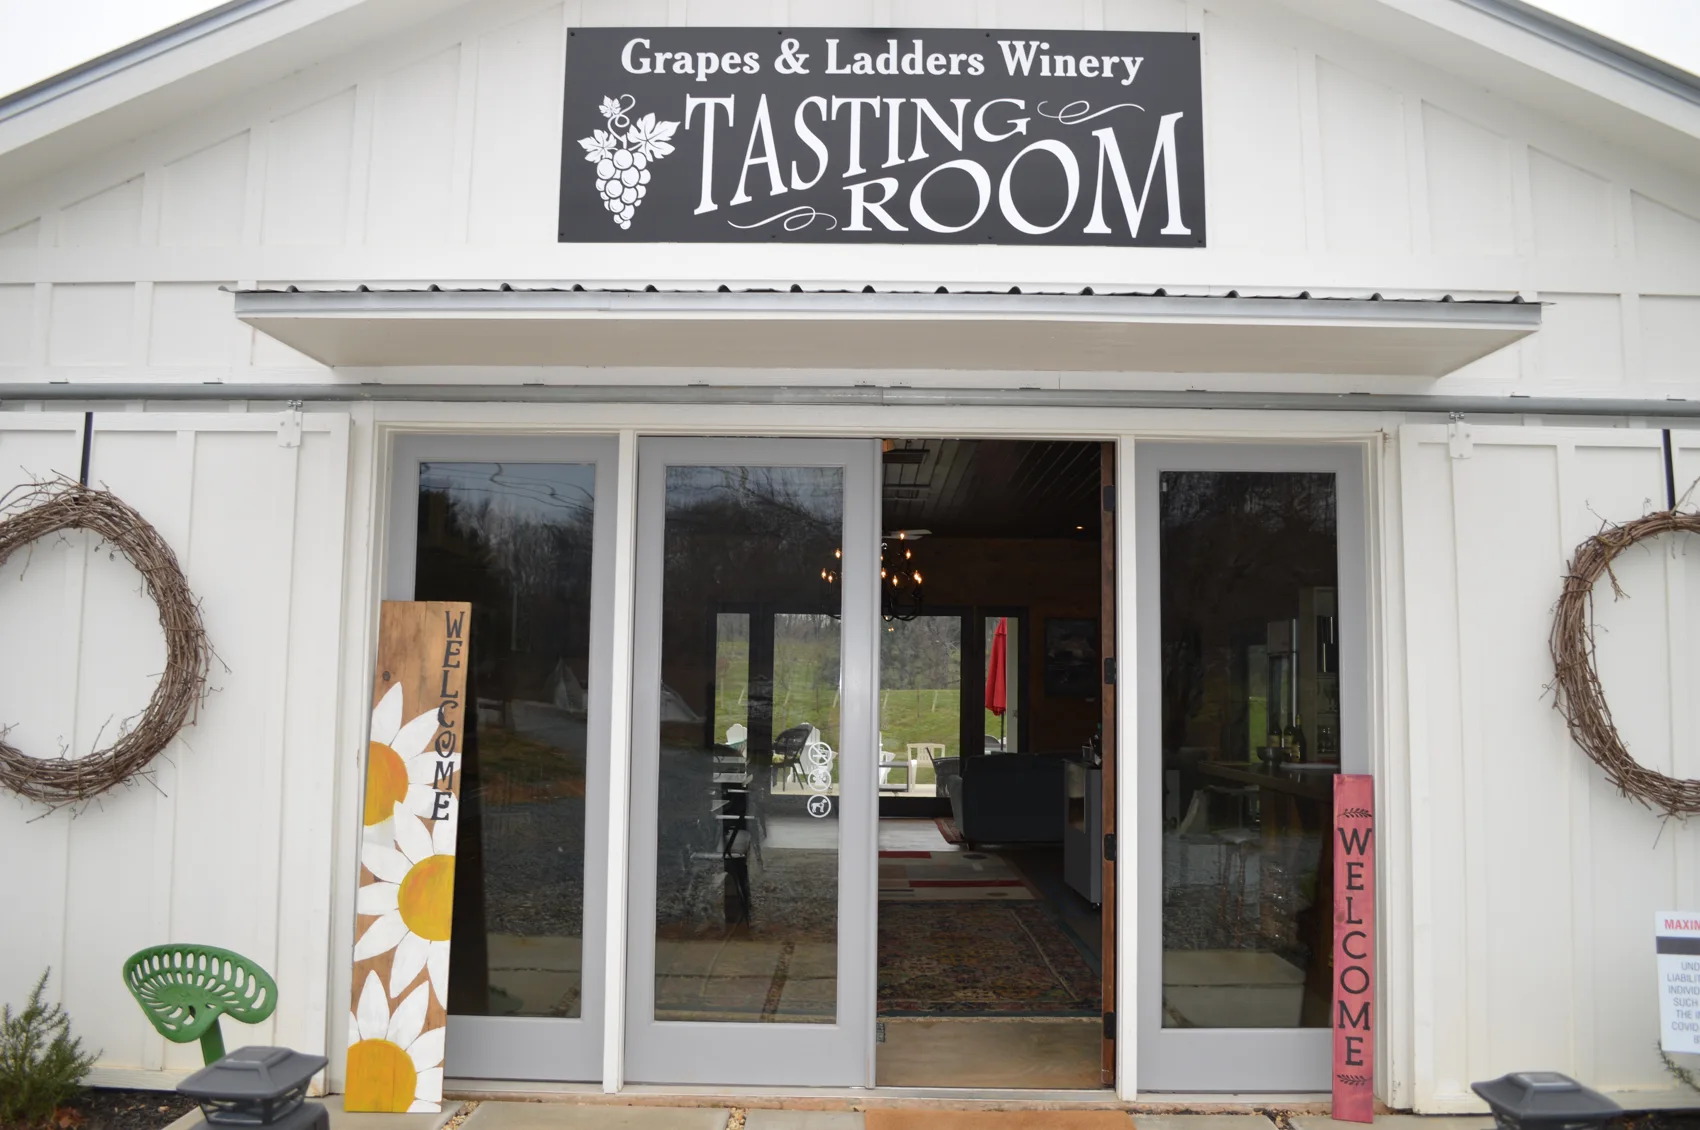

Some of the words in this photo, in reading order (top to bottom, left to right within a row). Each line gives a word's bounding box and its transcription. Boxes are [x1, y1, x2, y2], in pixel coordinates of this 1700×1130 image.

[622, 38, 761, 81] Grapes
[774, 38, 810, 75] &
[825, 38, 985, 77] Ladders
[997, 40, 1145, 86] Winery
[685, 93, 1031, 216] TASTING
[842, 112, 1192, 239] ROOM
[431, 610, 465, 821] WELCOME
[1337, 827, 1373, 1067] WELCOME
[1673, 997, 1699, 1007] SUCH
[1676, 1009, 1692, 1019] THE
